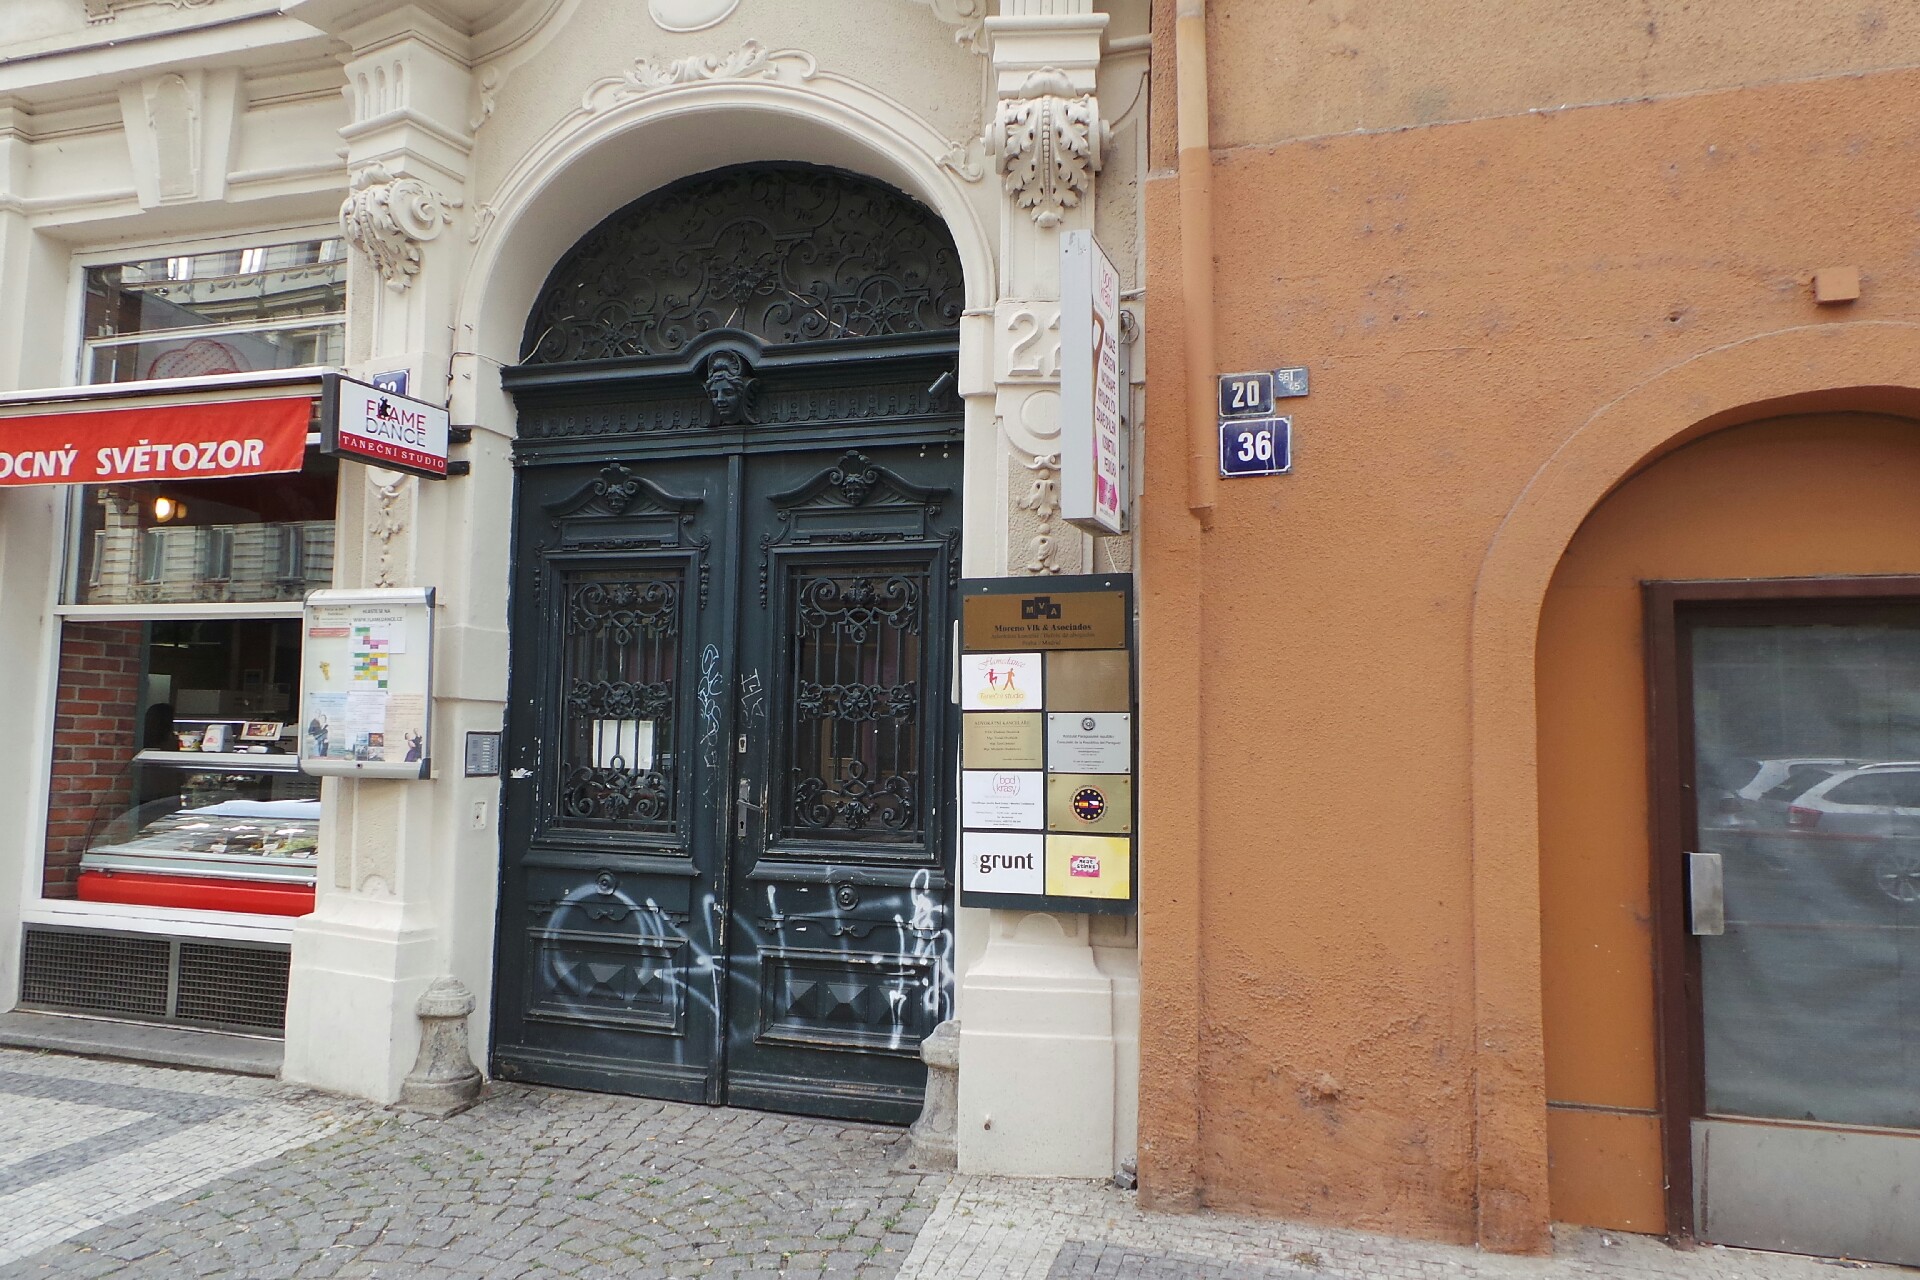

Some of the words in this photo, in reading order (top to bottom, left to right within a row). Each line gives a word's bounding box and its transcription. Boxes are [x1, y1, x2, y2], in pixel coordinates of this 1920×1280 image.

[1231, 380, 1260, 408] 20
[366, 399, 427, 431] FLAME
[365, 417, 426, 447] DANCE
[1237, 430, 1272, 462] 36
[96, 439, 264, 475] SVĚTOZOR
[342, 435, 397, 457] TANEČNÍ
[401, 450, 444, 468] STUDIO
[994, 624, 1025, 632] Moreno
[1052, 623, 1092, 631] Asociados
[979, 852, 1034, 874] grunt
